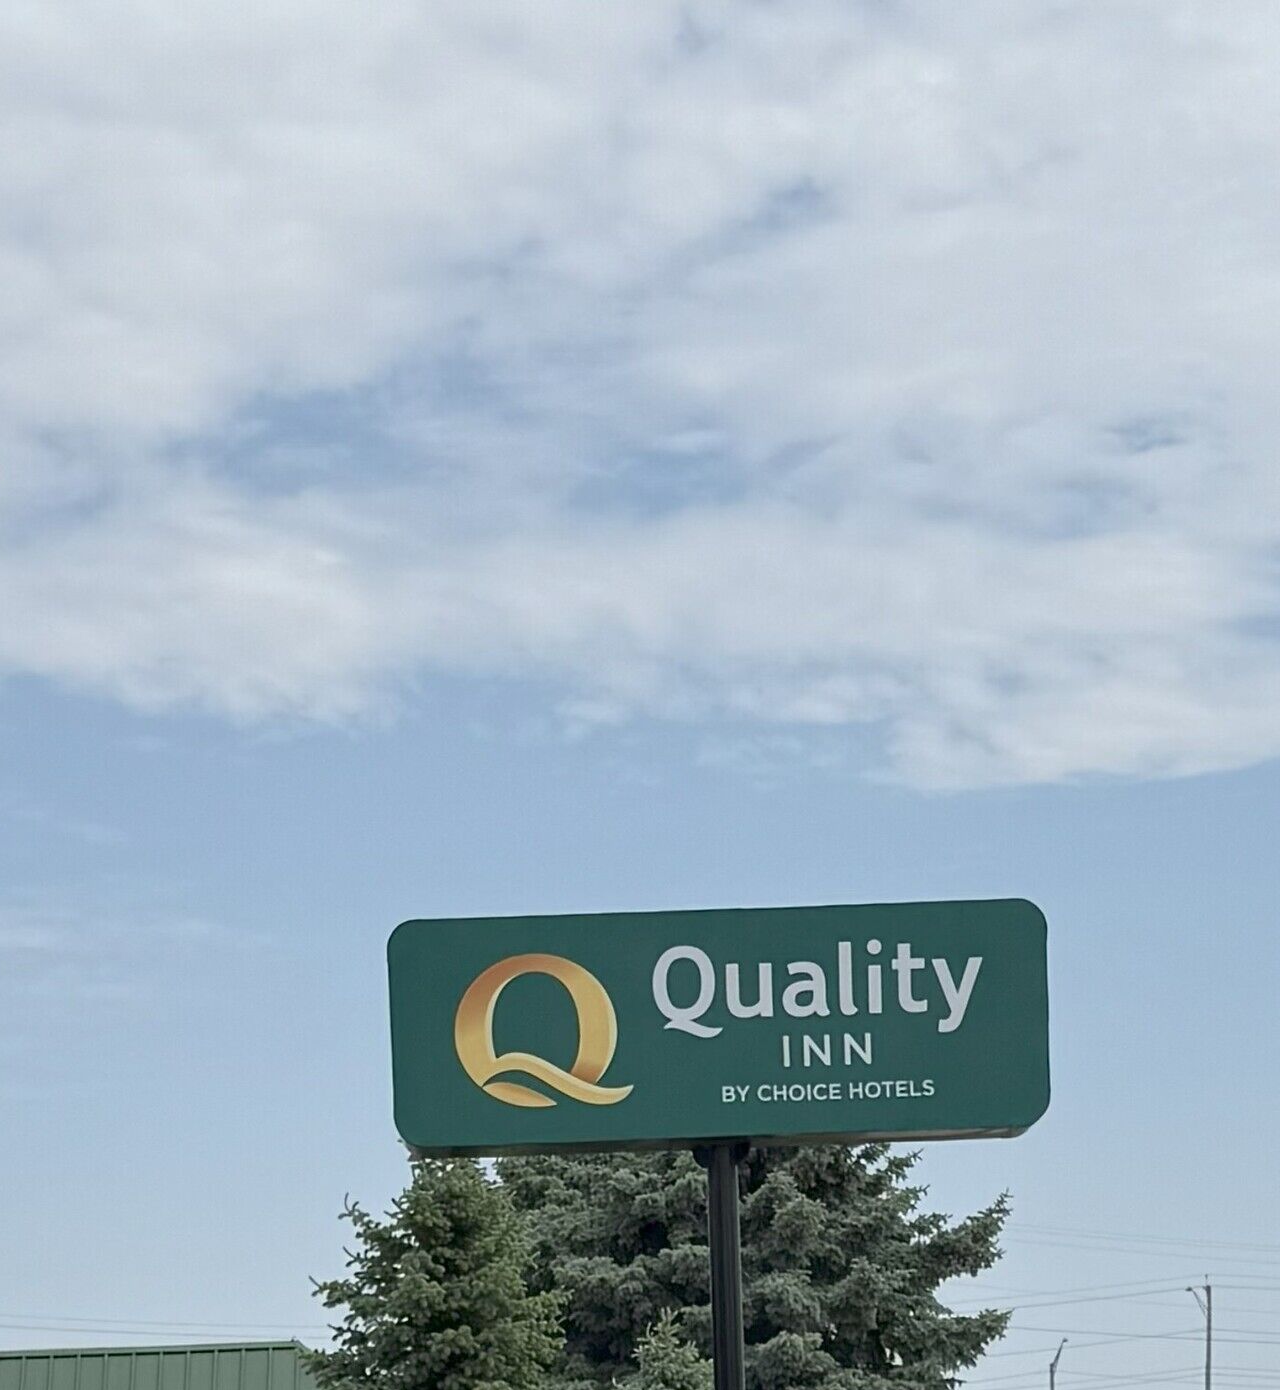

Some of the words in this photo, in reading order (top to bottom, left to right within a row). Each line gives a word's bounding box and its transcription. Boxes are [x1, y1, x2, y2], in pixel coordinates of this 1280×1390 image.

[652, 938, 983, 1038] Quality
[454, 953, 634, 1108] Q
[782, 1033, 872, 1068] INN
[721, 1085, 750, 1103] BY
[757, 1083, 842, 1102] CHOICE
[849, 1079, 935, 1100] HOTELS
